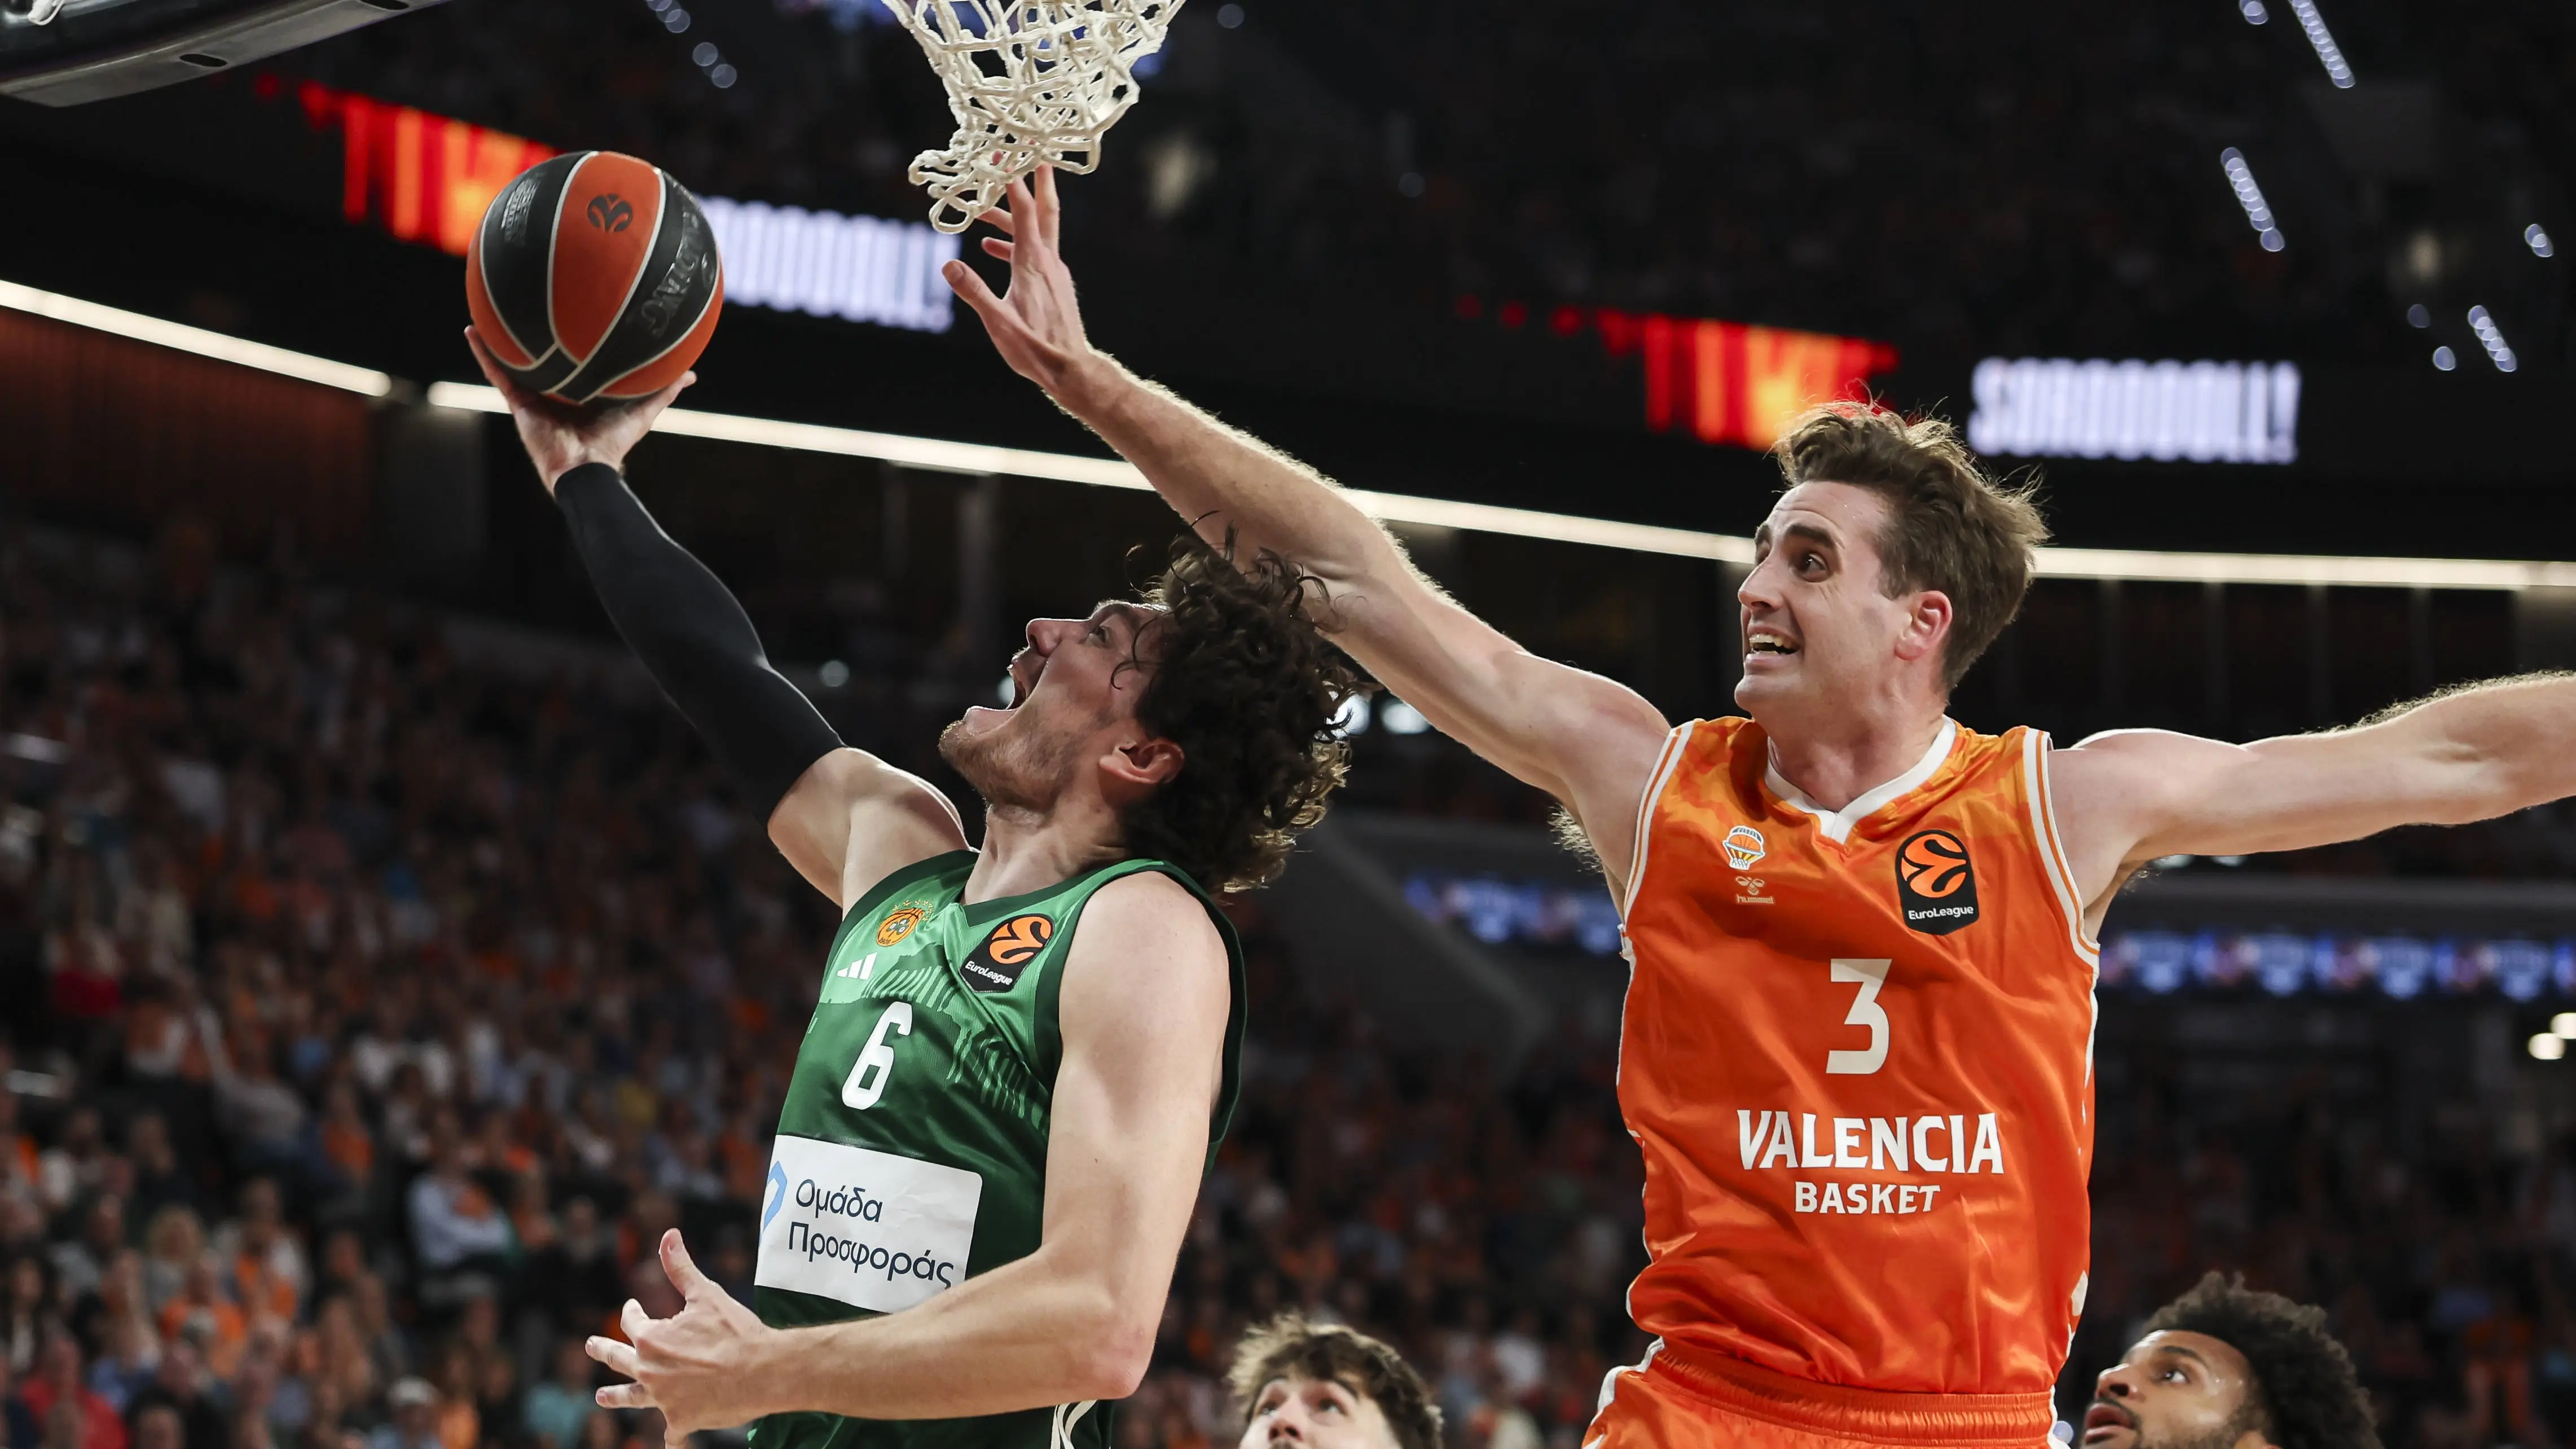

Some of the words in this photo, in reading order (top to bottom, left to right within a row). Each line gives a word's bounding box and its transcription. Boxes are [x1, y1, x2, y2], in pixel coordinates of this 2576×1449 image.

[1908, 904, 1974, 920] EuroLeague
[965, 960, 1013, 985] EuroLeague
[1826, 958, 1892, 1074] 3
[842, 1001, 912, 1110] 6
[1737, 1109, 2004, 1174] VALENCIA
[795, 1179, 883, 1222] Ομάδα
[1795, 1181, 1941, 1214] BASKET
[789, 1222, 954, 1289] Προσφοράς
